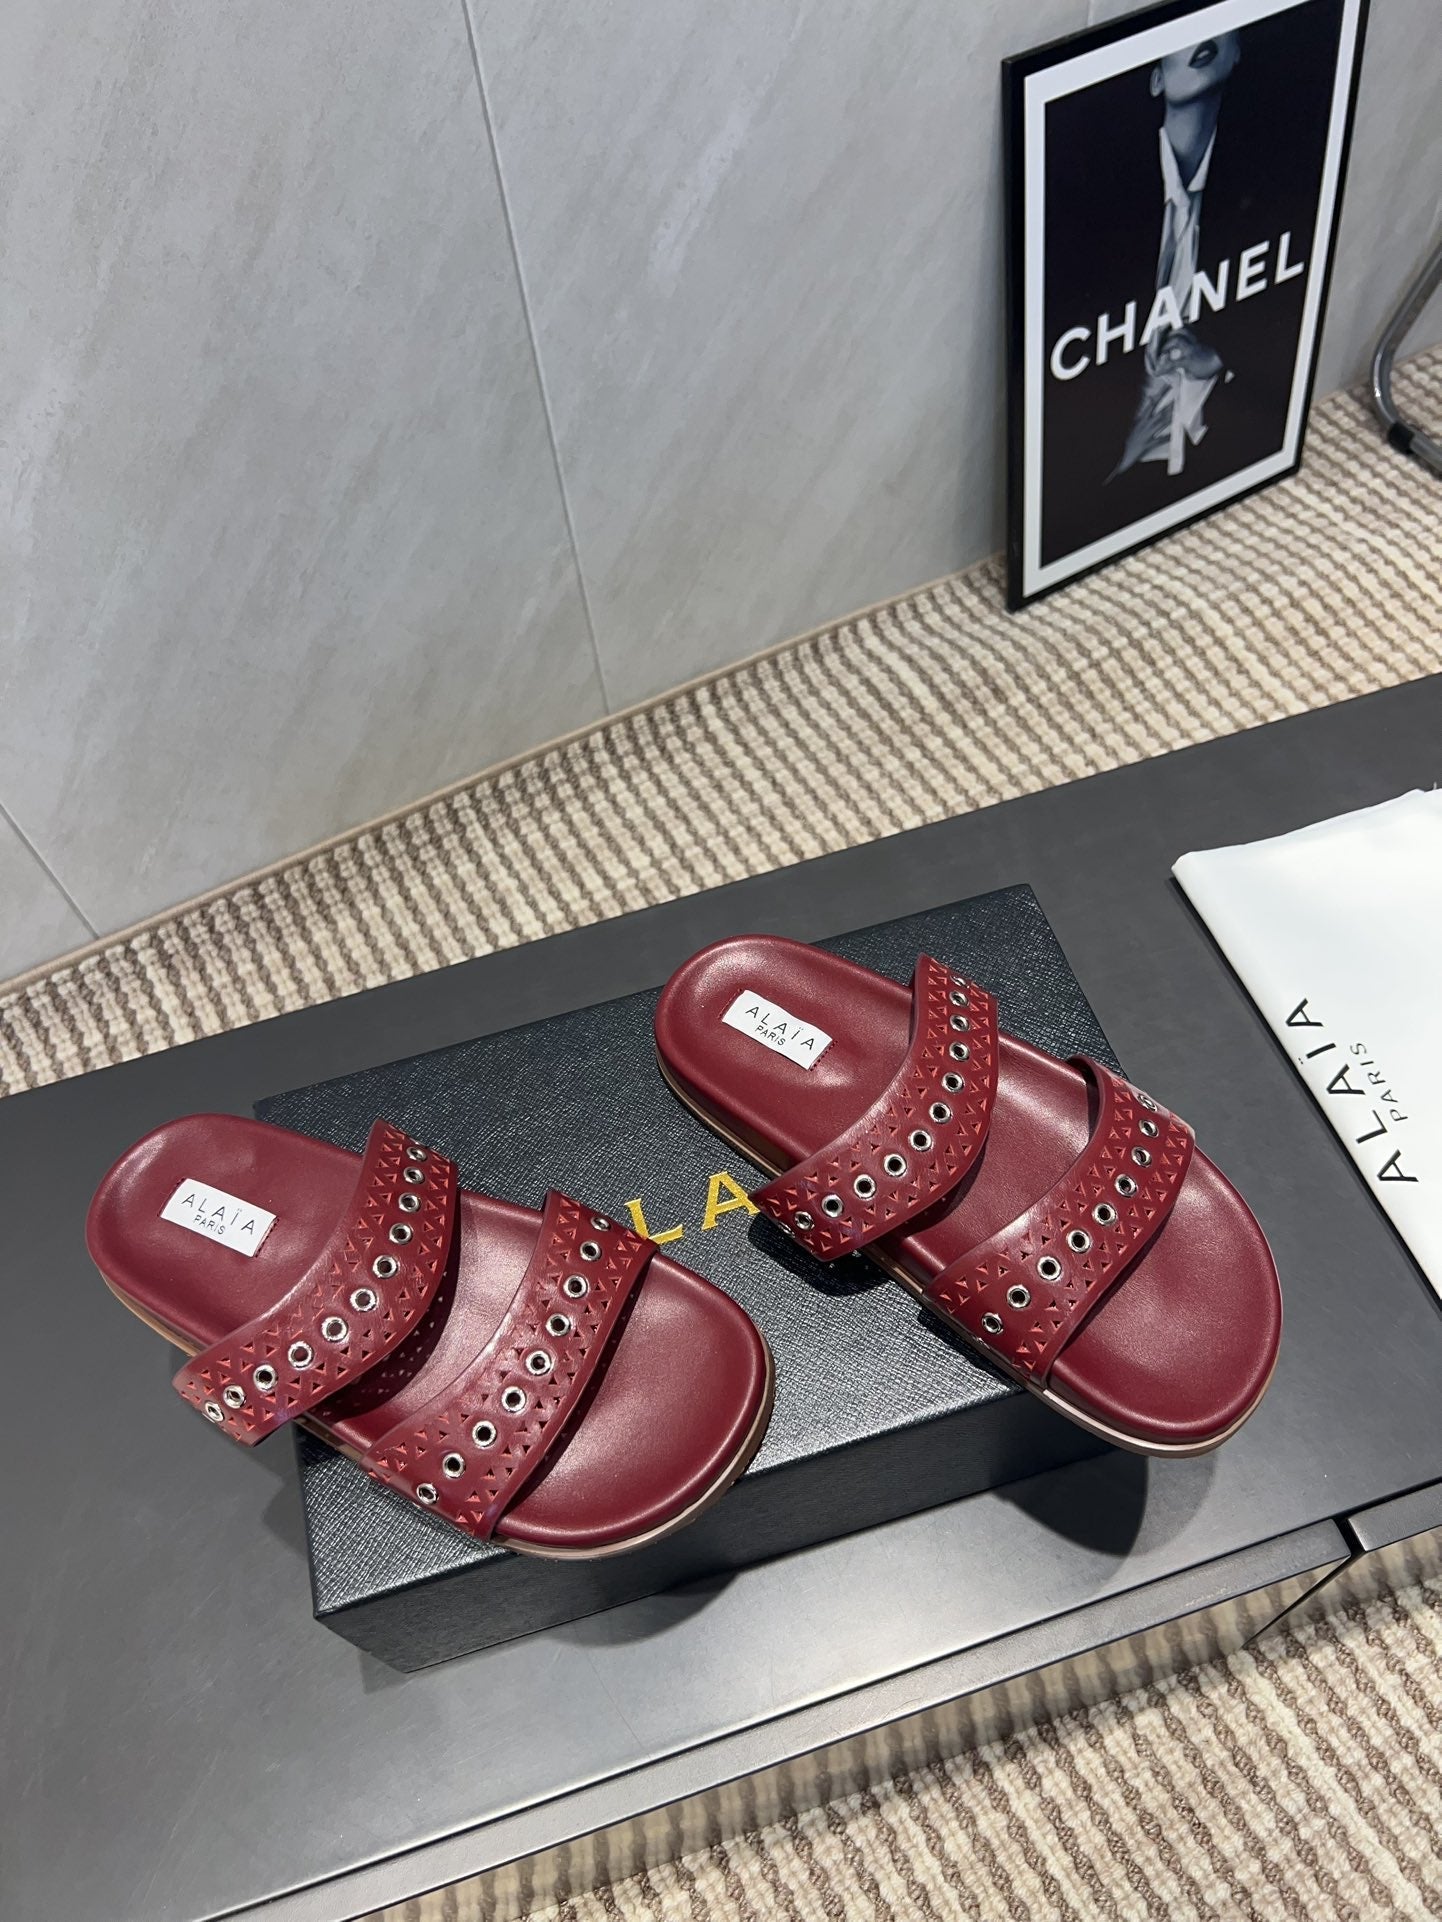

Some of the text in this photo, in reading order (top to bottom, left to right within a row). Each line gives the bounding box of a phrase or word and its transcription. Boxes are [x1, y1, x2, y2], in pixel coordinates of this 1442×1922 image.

[1050, 231, 1304, 381] CHANEL
[745, 1006, 815, 1050] ALAÏA
[755, 1025, 786, 1046] PARIS
[1285, 997, 1419, 1182] ALAÏA
[1350, 1042, 1408, 1122] PARIS
[181, 1193, 255, 1235] ALAÏA
[193, 1214, 226, 1235] PARIS
